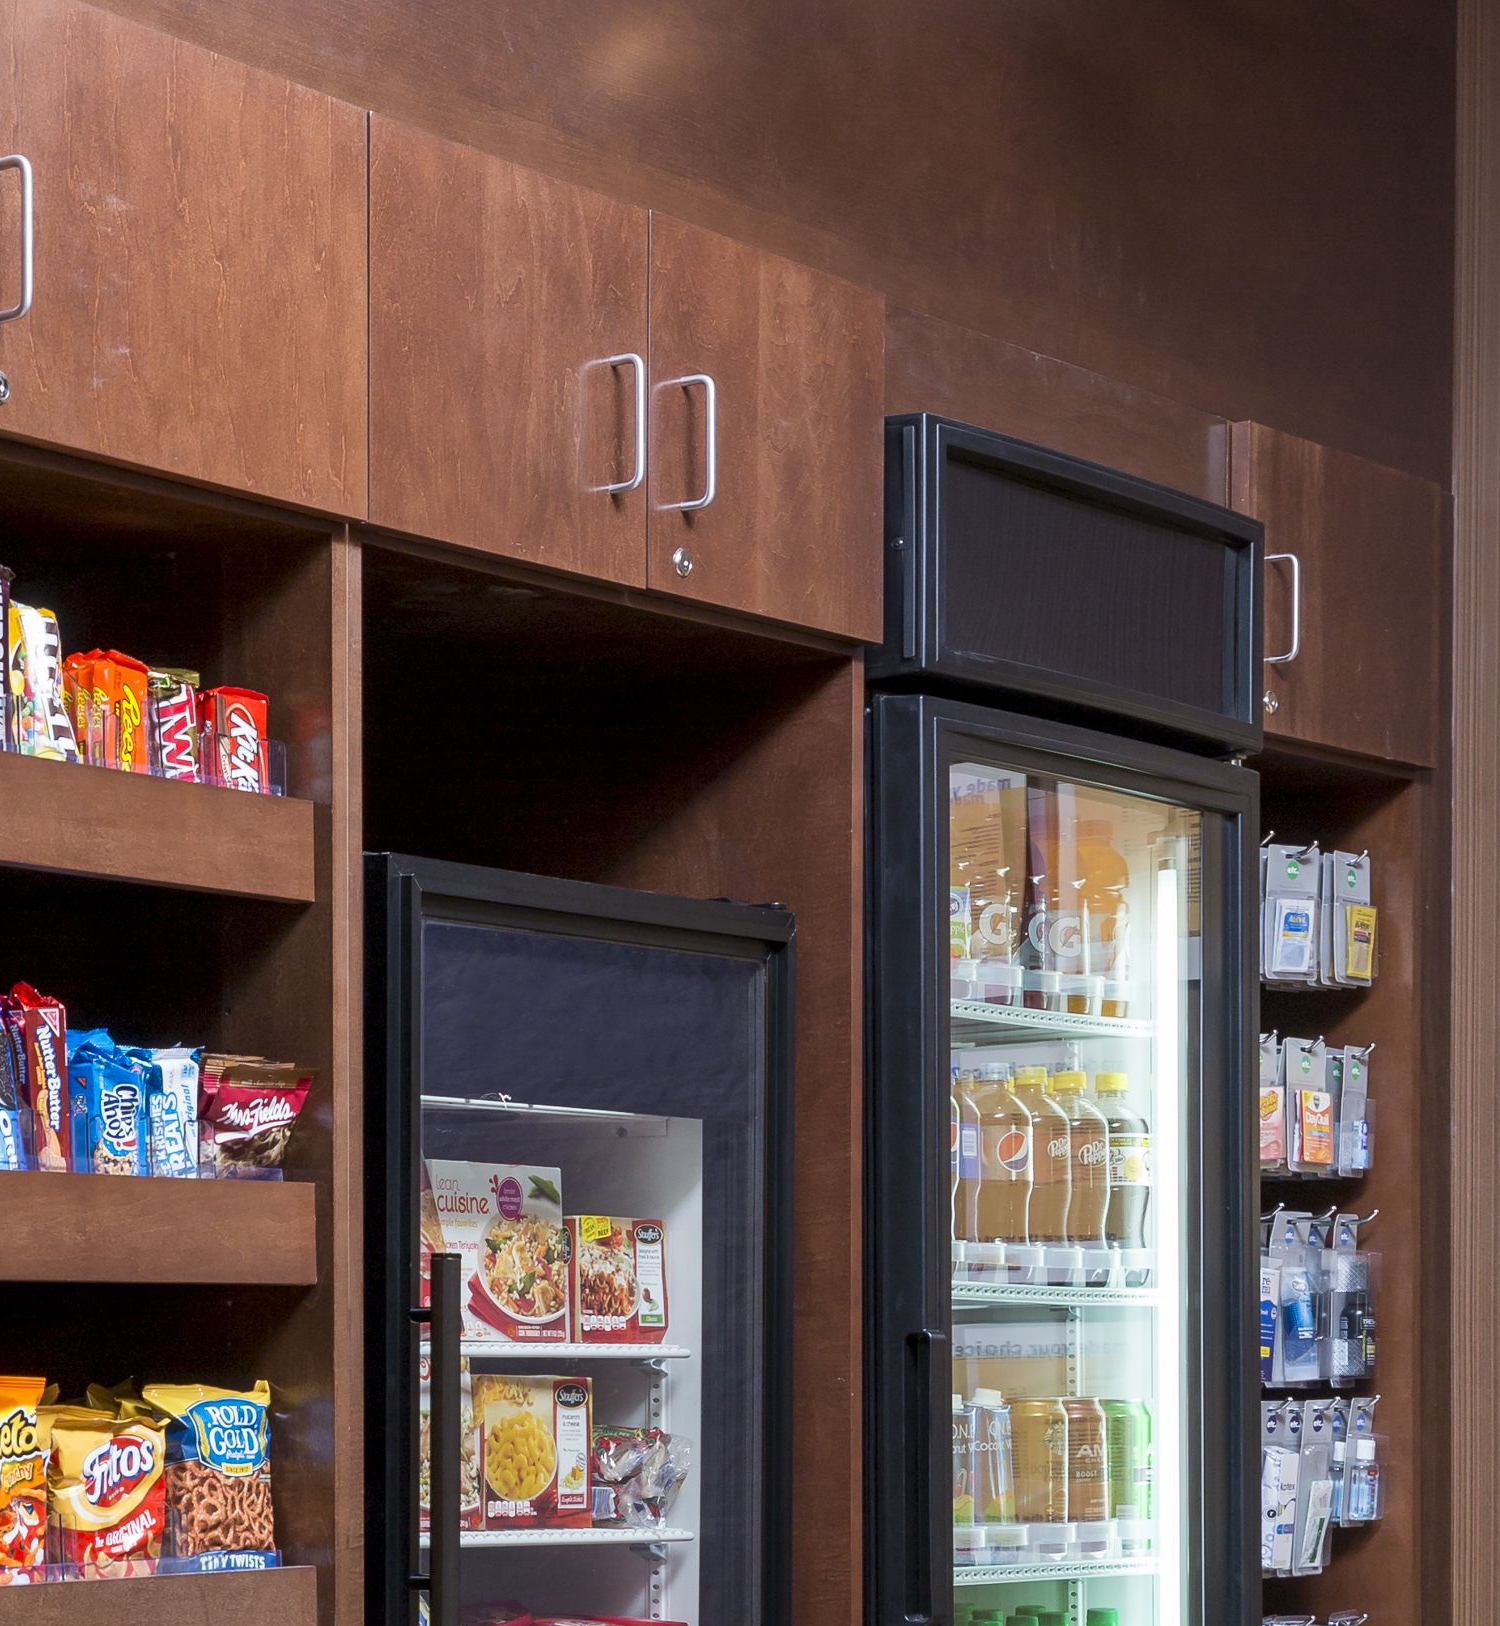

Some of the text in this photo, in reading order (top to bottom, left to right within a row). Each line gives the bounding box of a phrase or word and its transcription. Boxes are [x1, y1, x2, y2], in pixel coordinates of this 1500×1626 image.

[115, 1084, 139, 1140] Chips
[162, 1092, 186, 1172] REATS
[436, 1174, 461, 1192] lean
[437, 1192, 490, 1215] cuisine
[205, 1404, 257, 1429] ROLD
[209, 1427, 260, 1457] GOLD
[1075, 1470, 1098, 1478] BOOST
[229, 1553, 266, 1570] TWISTS
